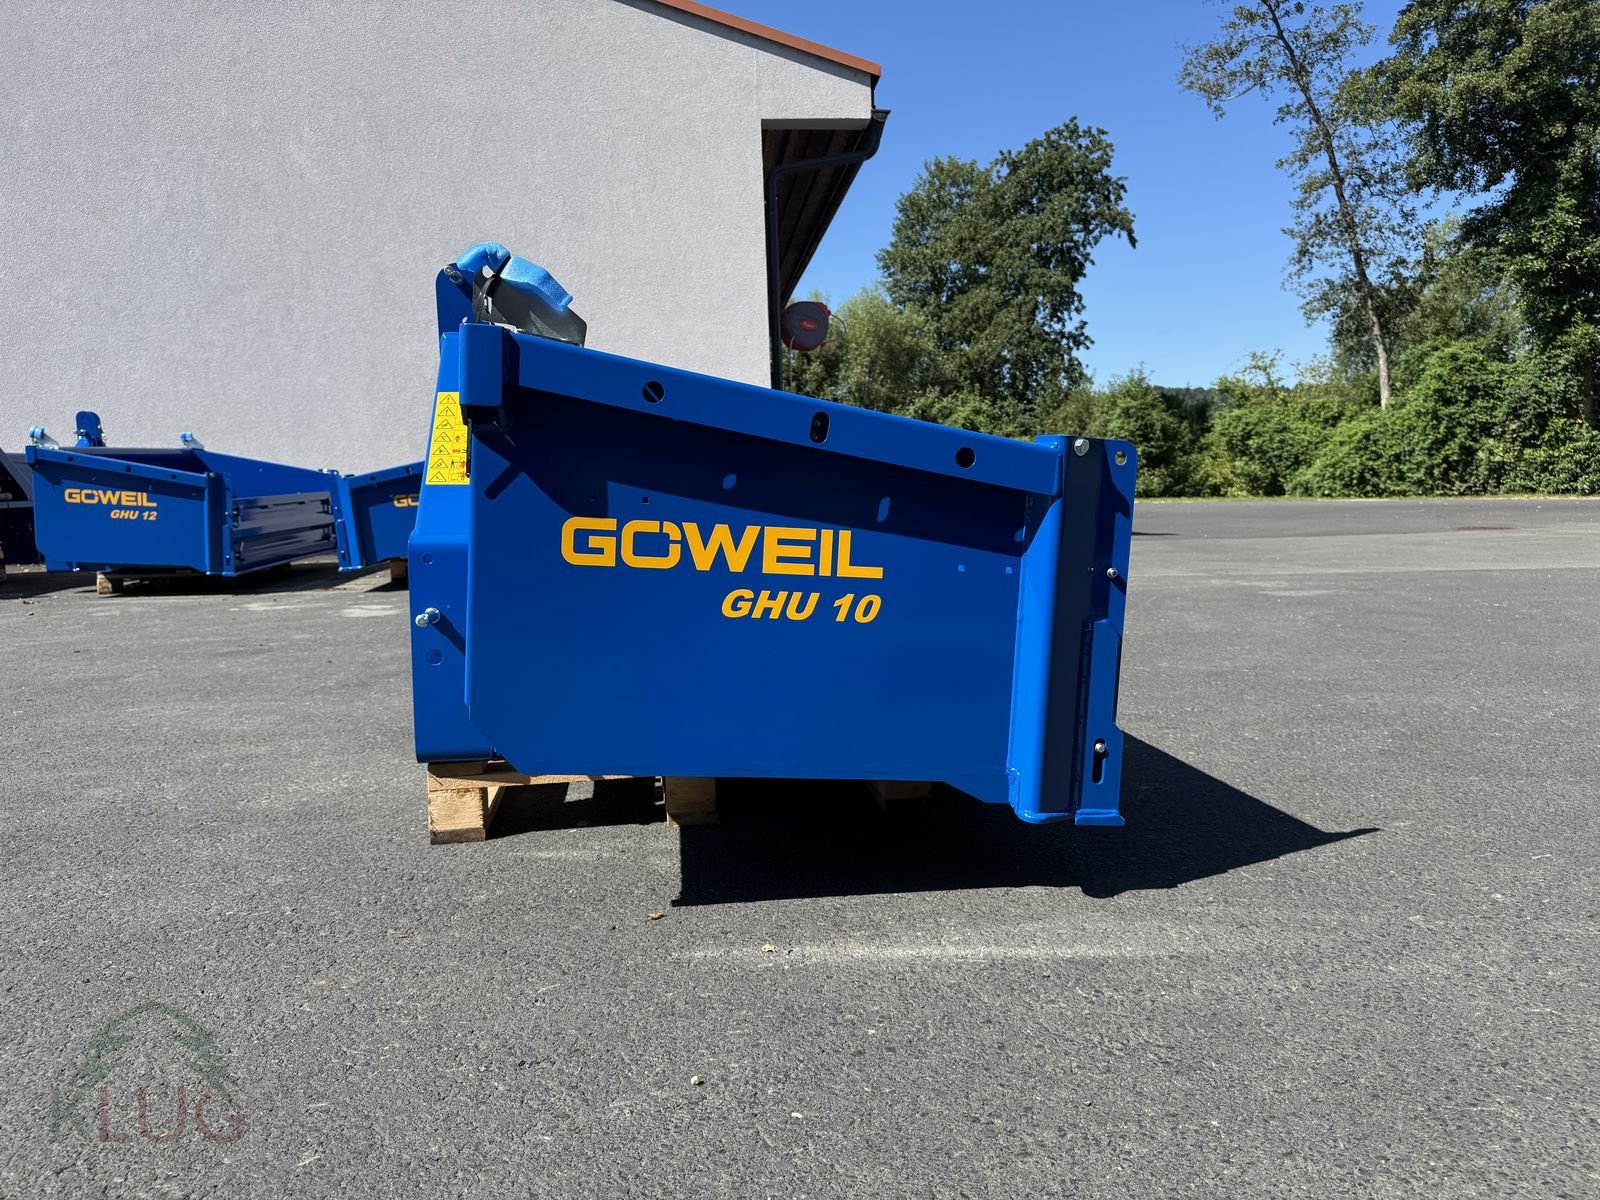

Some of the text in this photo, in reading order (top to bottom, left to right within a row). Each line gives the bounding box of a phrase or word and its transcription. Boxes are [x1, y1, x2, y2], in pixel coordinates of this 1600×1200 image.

[110, 509, 157, 521] GHU 12
[721, 588, 882, 624] GHU 10
